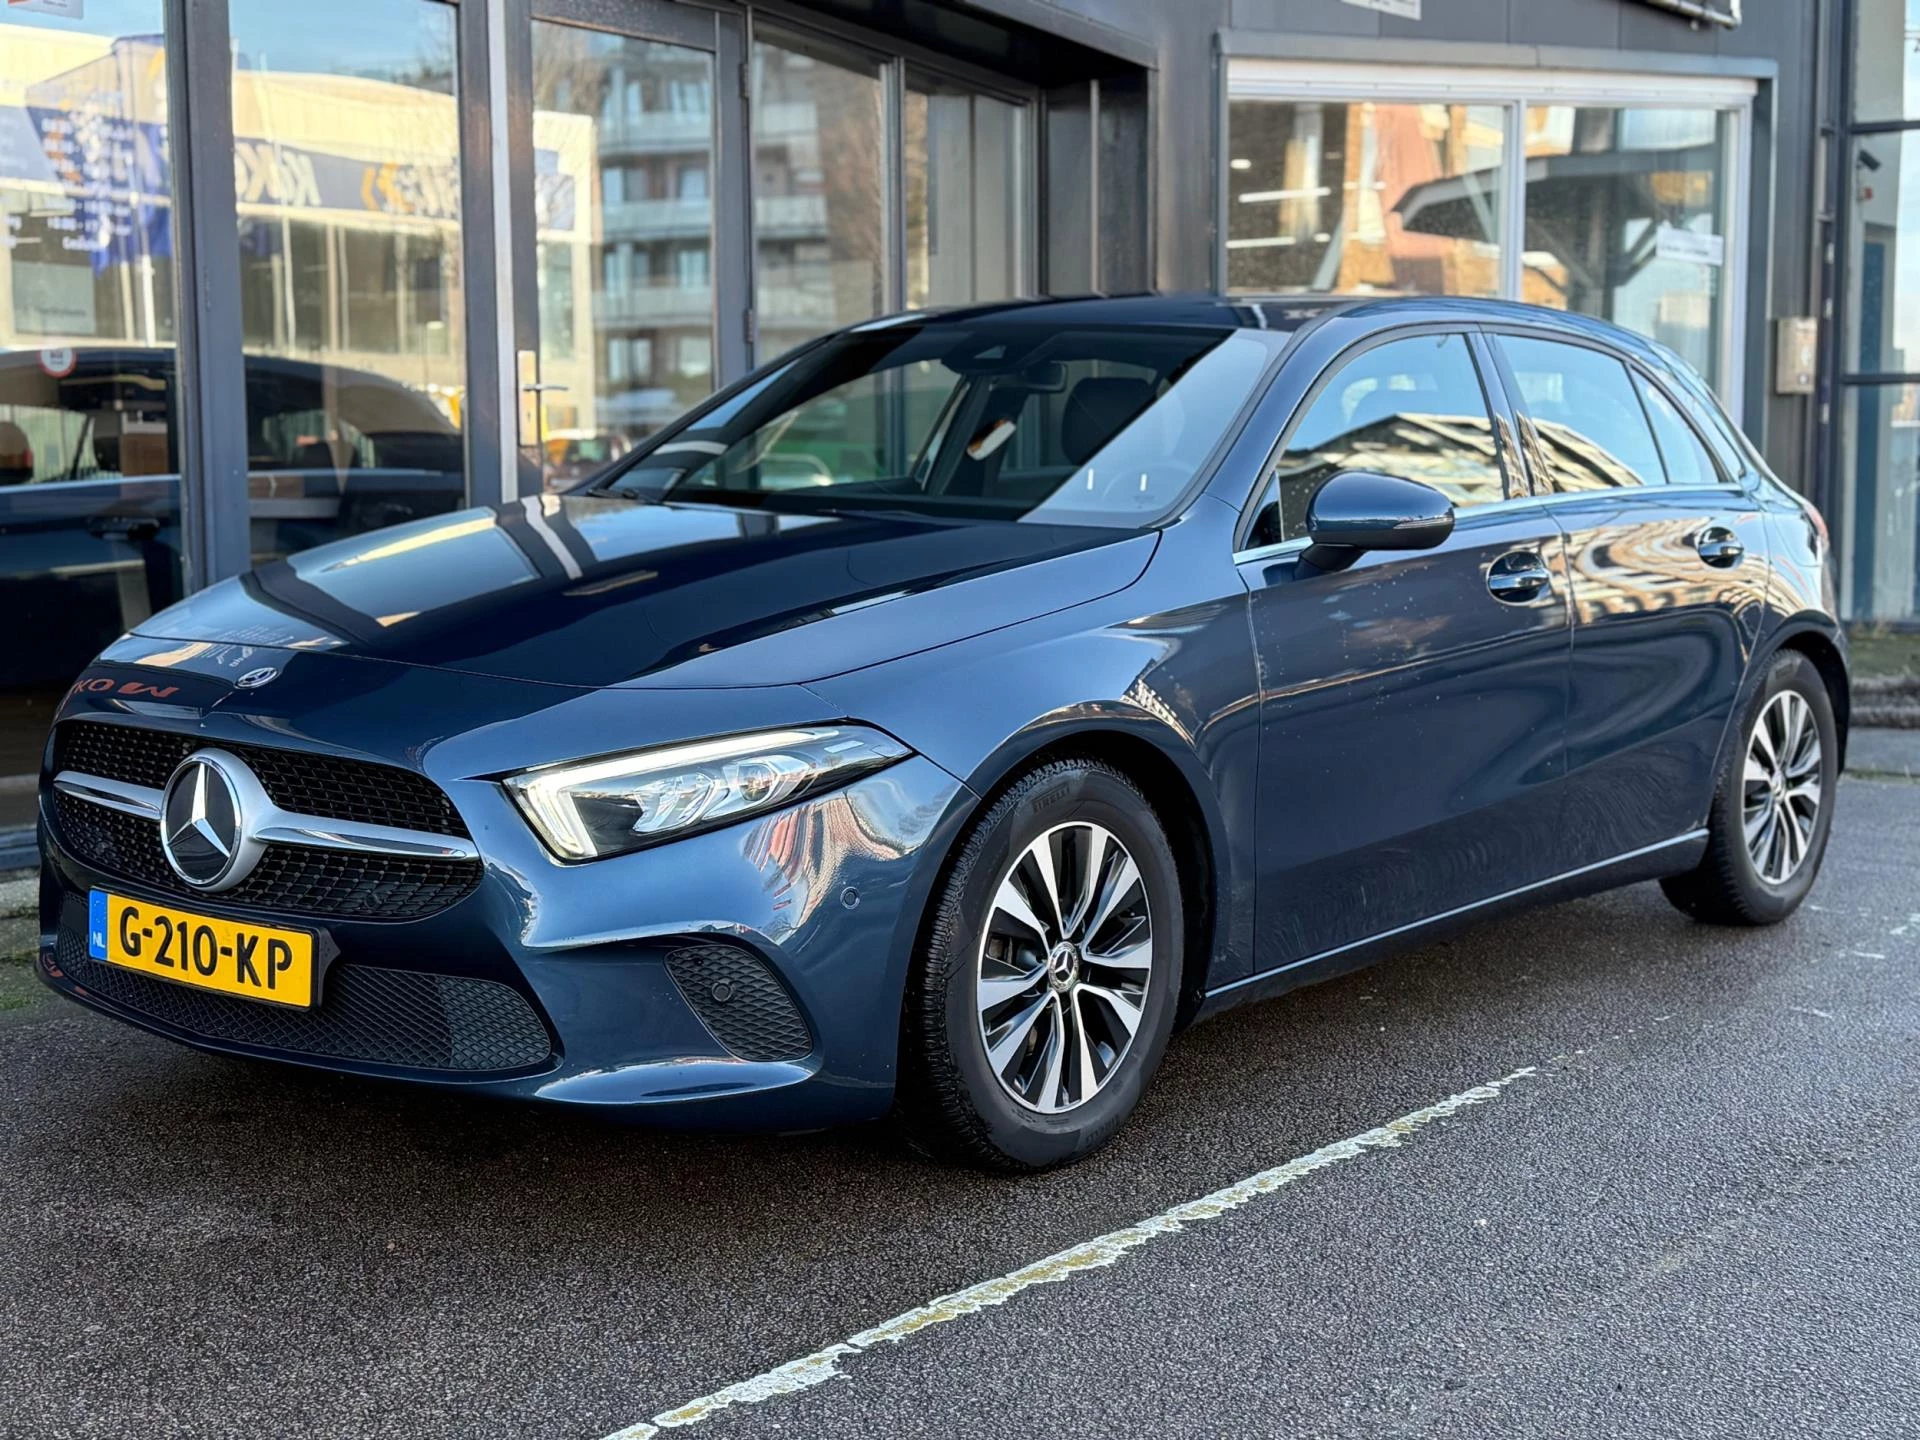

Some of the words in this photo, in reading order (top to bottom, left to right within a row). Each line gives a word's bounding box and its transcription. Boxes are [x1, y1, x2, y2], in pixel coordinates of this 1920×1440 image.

[1033, 782, 1070, 816] PIRELLI
[92, 930, 106, 949] NL
[119, 906, 293, 990] G-210-KP
